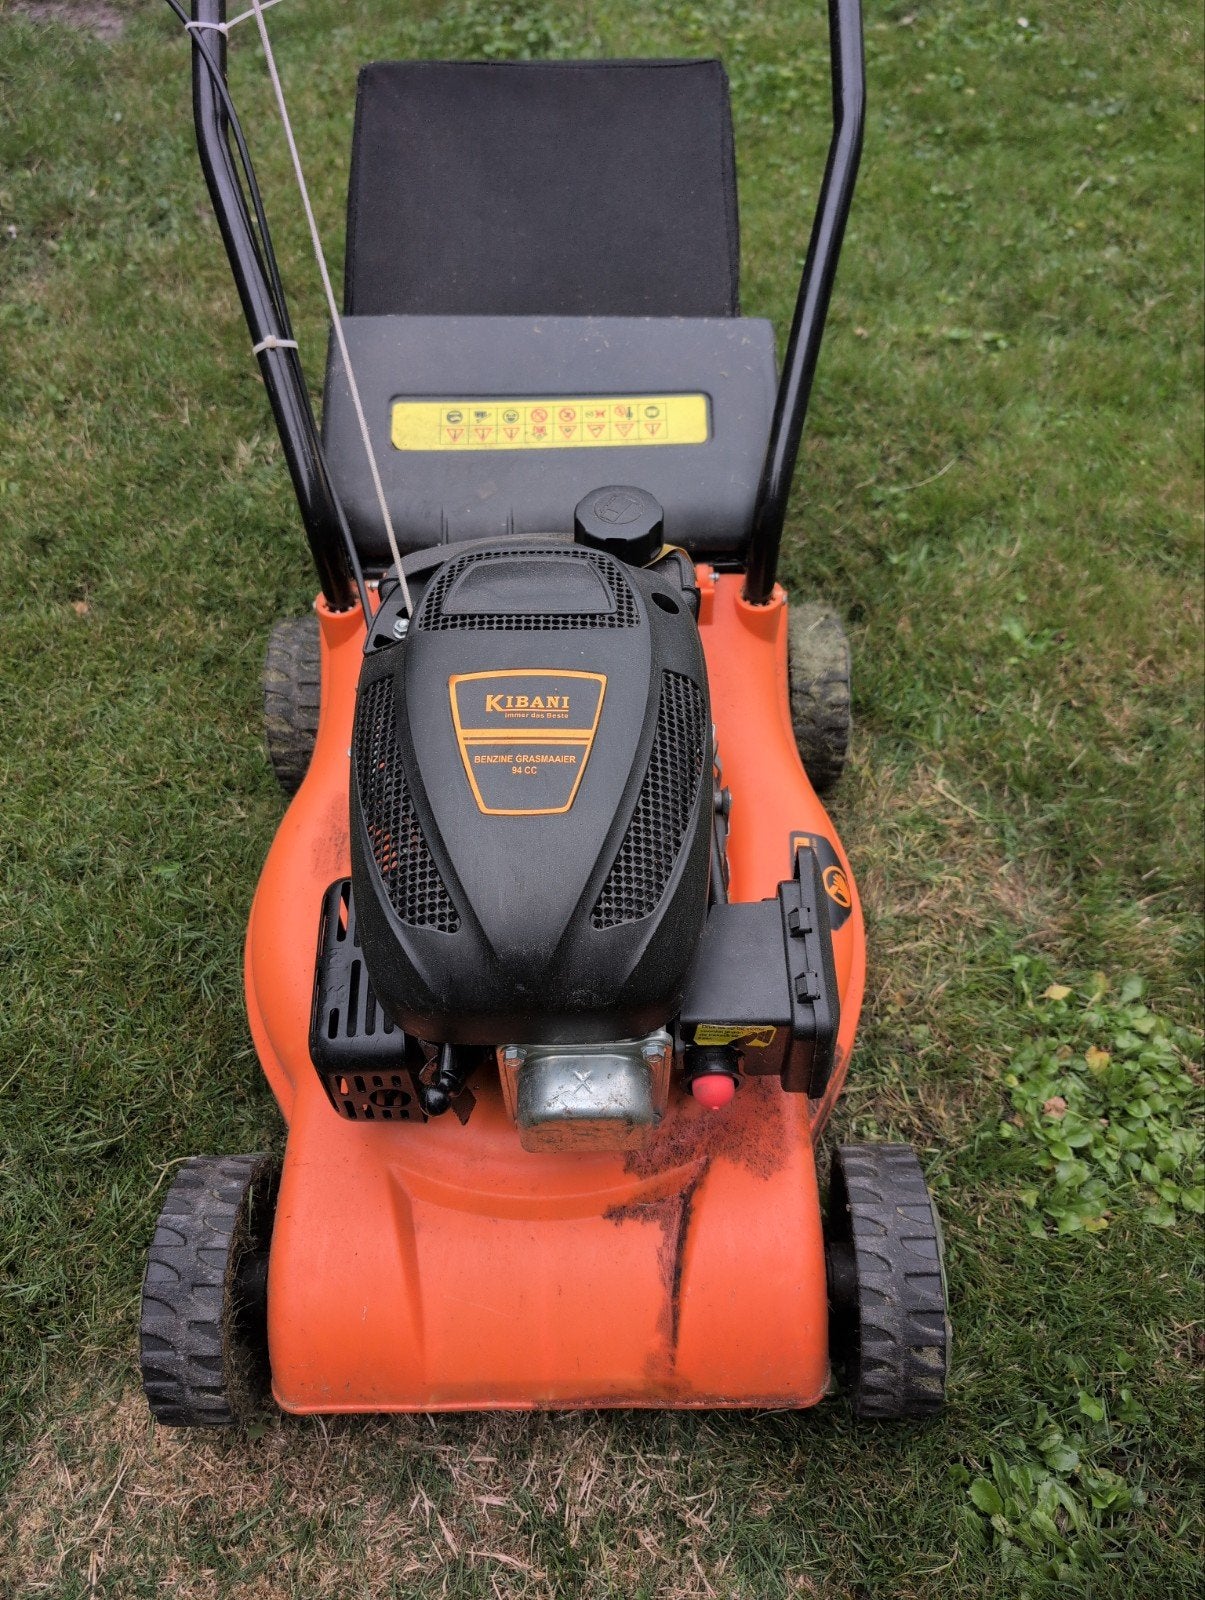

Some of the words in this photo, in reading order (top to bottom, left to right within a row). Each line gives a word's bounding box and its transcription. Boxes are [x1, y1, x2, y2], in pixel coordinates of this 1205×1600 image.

[485, 694, 570, 712] KIBANI
[474, 755, 513, 763] BENZINE
[515, 754, 576, 763] GRASMAAIER
[511, 766, 522, 775] 94
[524, 766, 537, 775] CC
